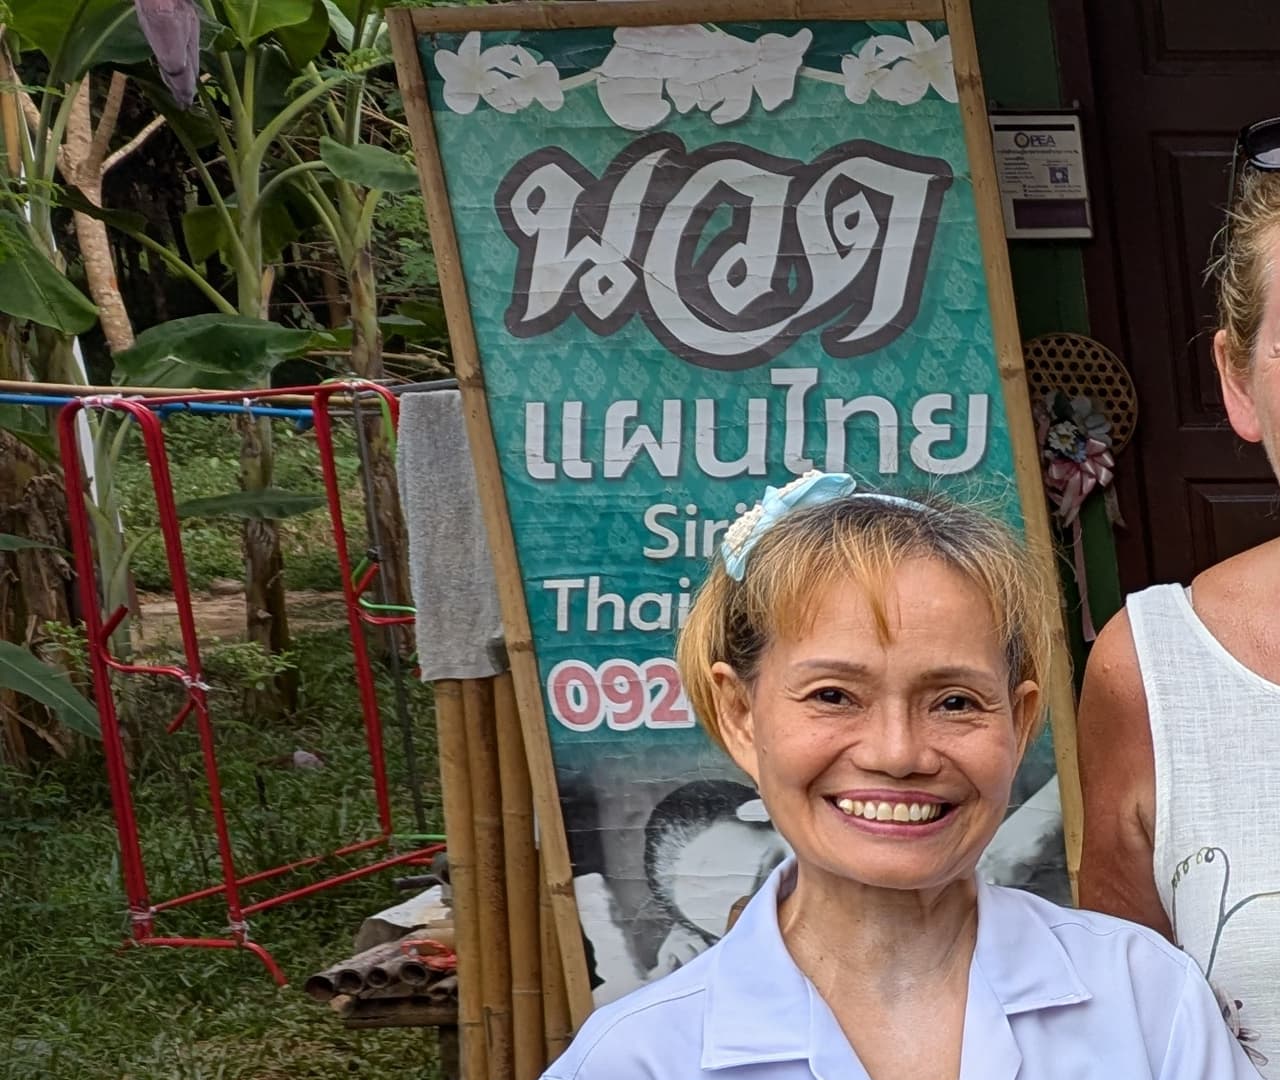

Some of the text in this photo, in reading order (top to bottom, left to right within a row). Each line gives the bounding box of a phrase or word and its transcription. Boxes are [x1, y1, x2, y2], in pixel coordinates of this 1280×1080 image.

[503, 140, 944, 362] นวด
[524, 367, 990, 481] แผนไทย
[643, 502, 748, 560] Sir
[543, 575, 692, 632] Thai
[547, 657, 697, 733] 092
